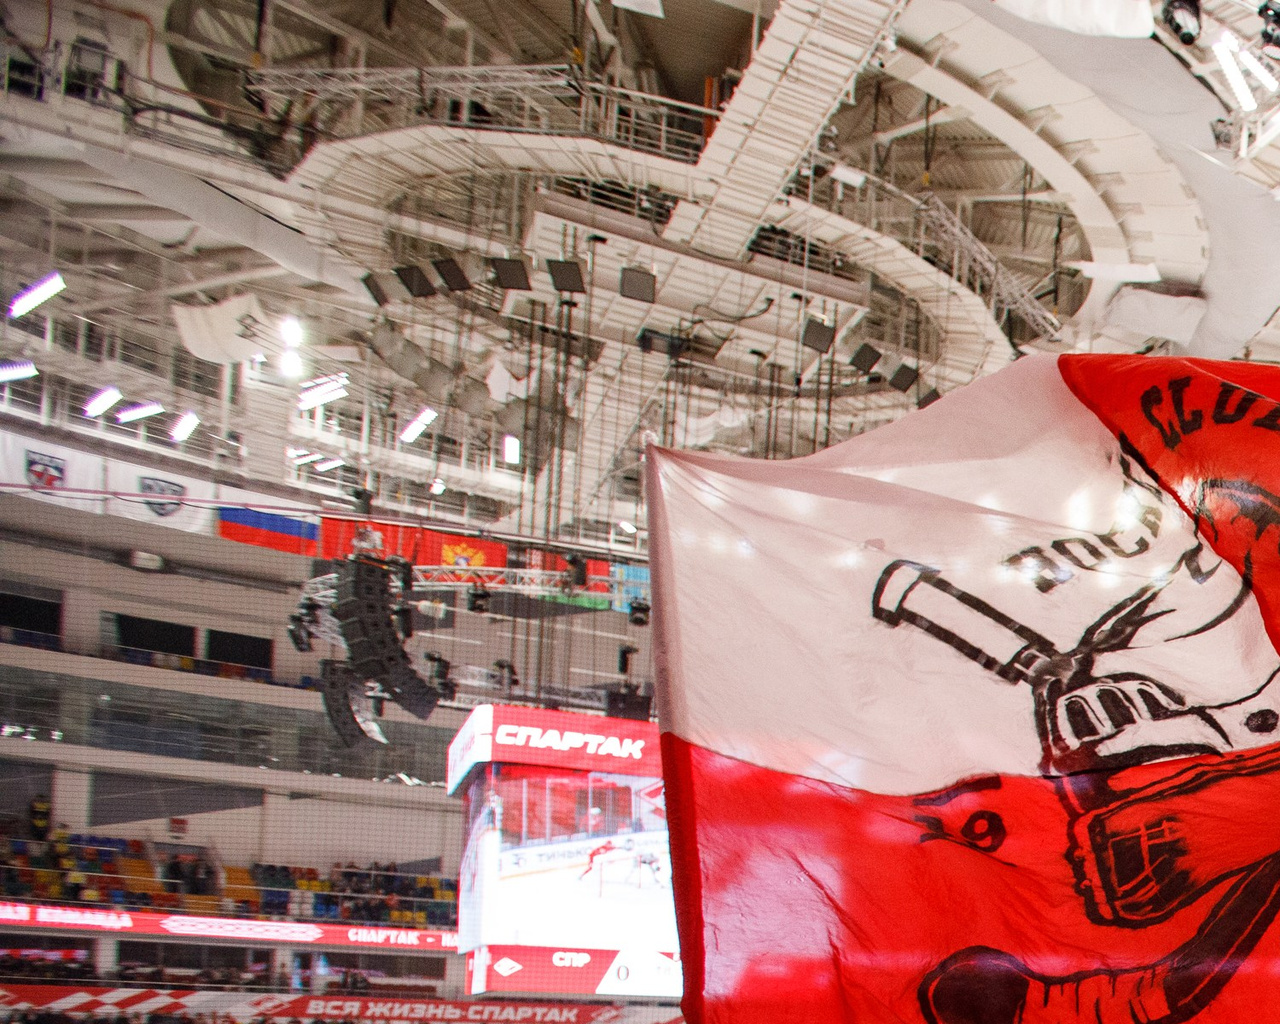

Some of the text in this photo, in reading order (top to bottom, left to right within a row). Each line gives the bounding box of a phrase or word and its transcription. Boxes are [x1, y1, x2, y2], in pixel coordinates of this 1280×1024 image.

[494, 724, 646, 760] СПАРТАК
[551, 951, 592, 968] СПР
[616, 965, 630, 981] 0
[305, 1000, 361, 1017] ВСЯ
